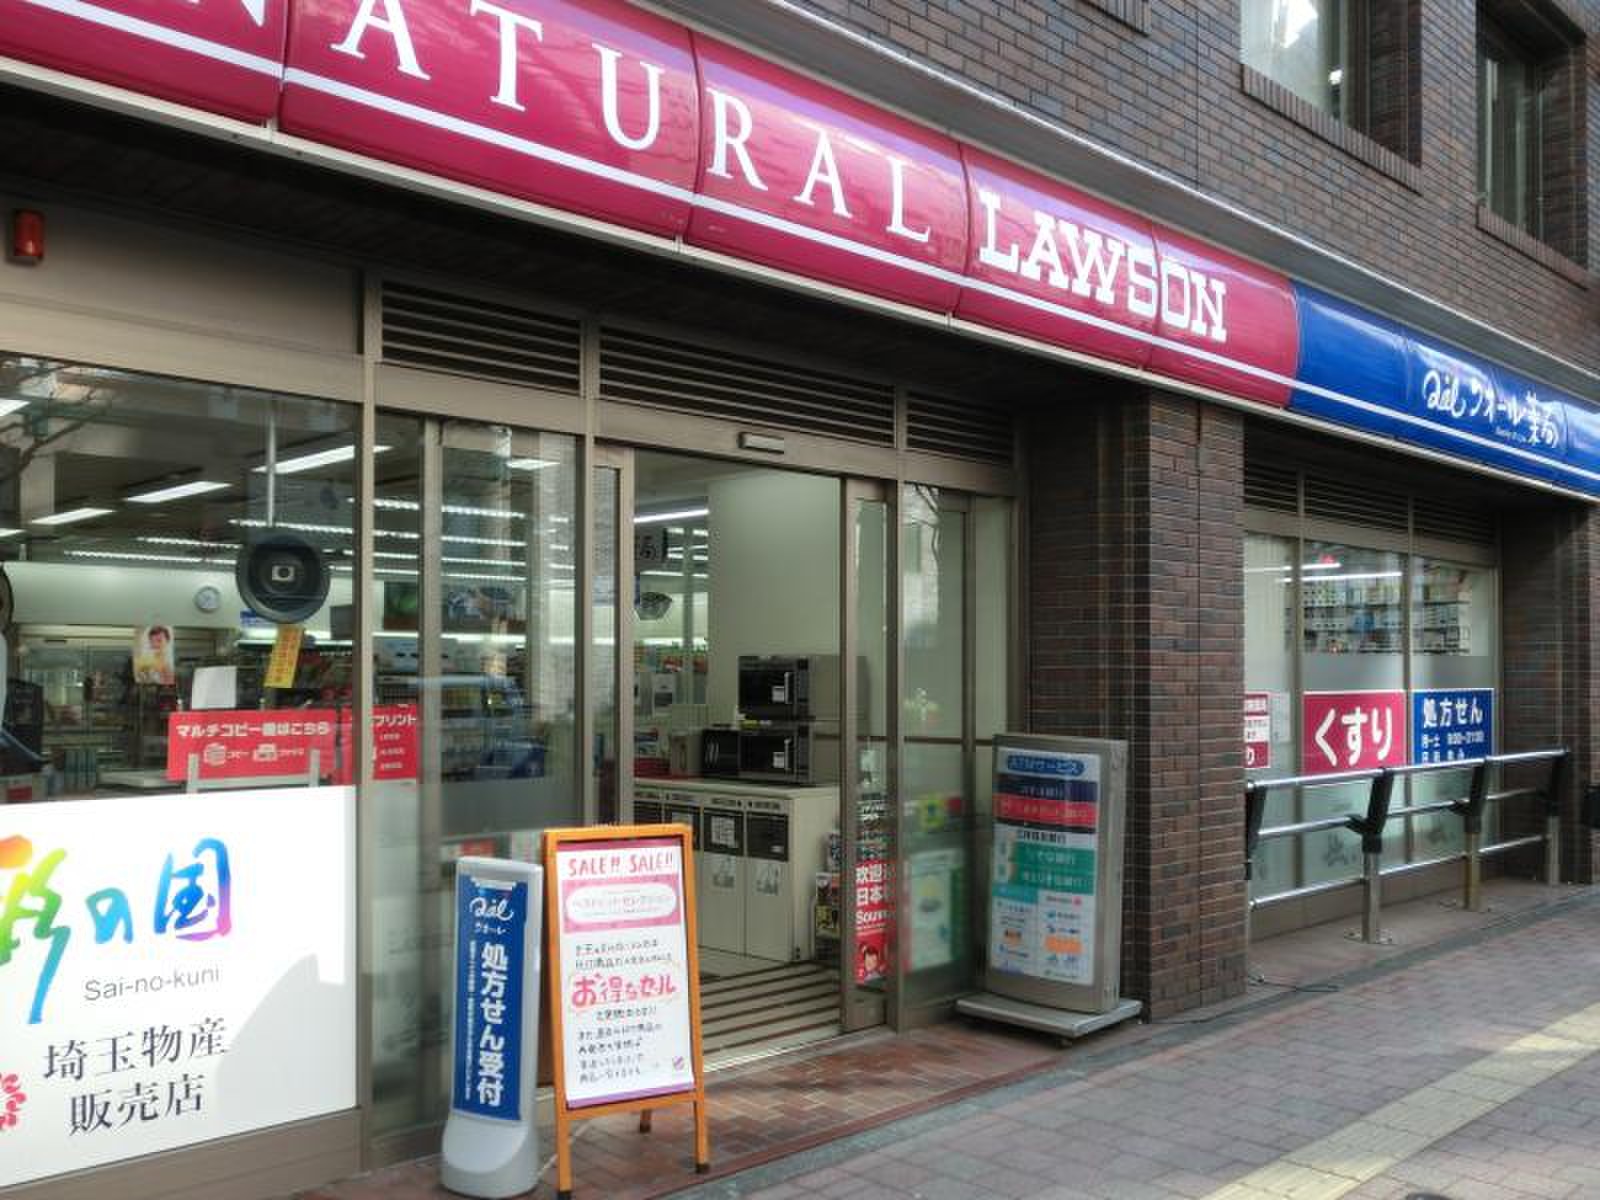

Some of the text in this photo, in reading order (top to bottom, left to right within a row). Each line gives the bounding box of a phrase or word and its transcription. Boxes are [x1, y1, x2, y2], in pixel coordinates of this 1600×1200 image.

[189, 0, 1228, 343] ATURAL LAWSON
[1314, 706, 1393, 767] くすり
[1423, 696, 1484, 728] 処方せん
[568, 851, 674, 878] SALE!! SALE!!
[84, 965, 221, 1003] Sai-no-kuni
[43, 1016, 229, 1084] 埼玉物産
[475, 941, 510, 1107] 処方せん受付
[68, 1072, 208, 1138] 販売店
